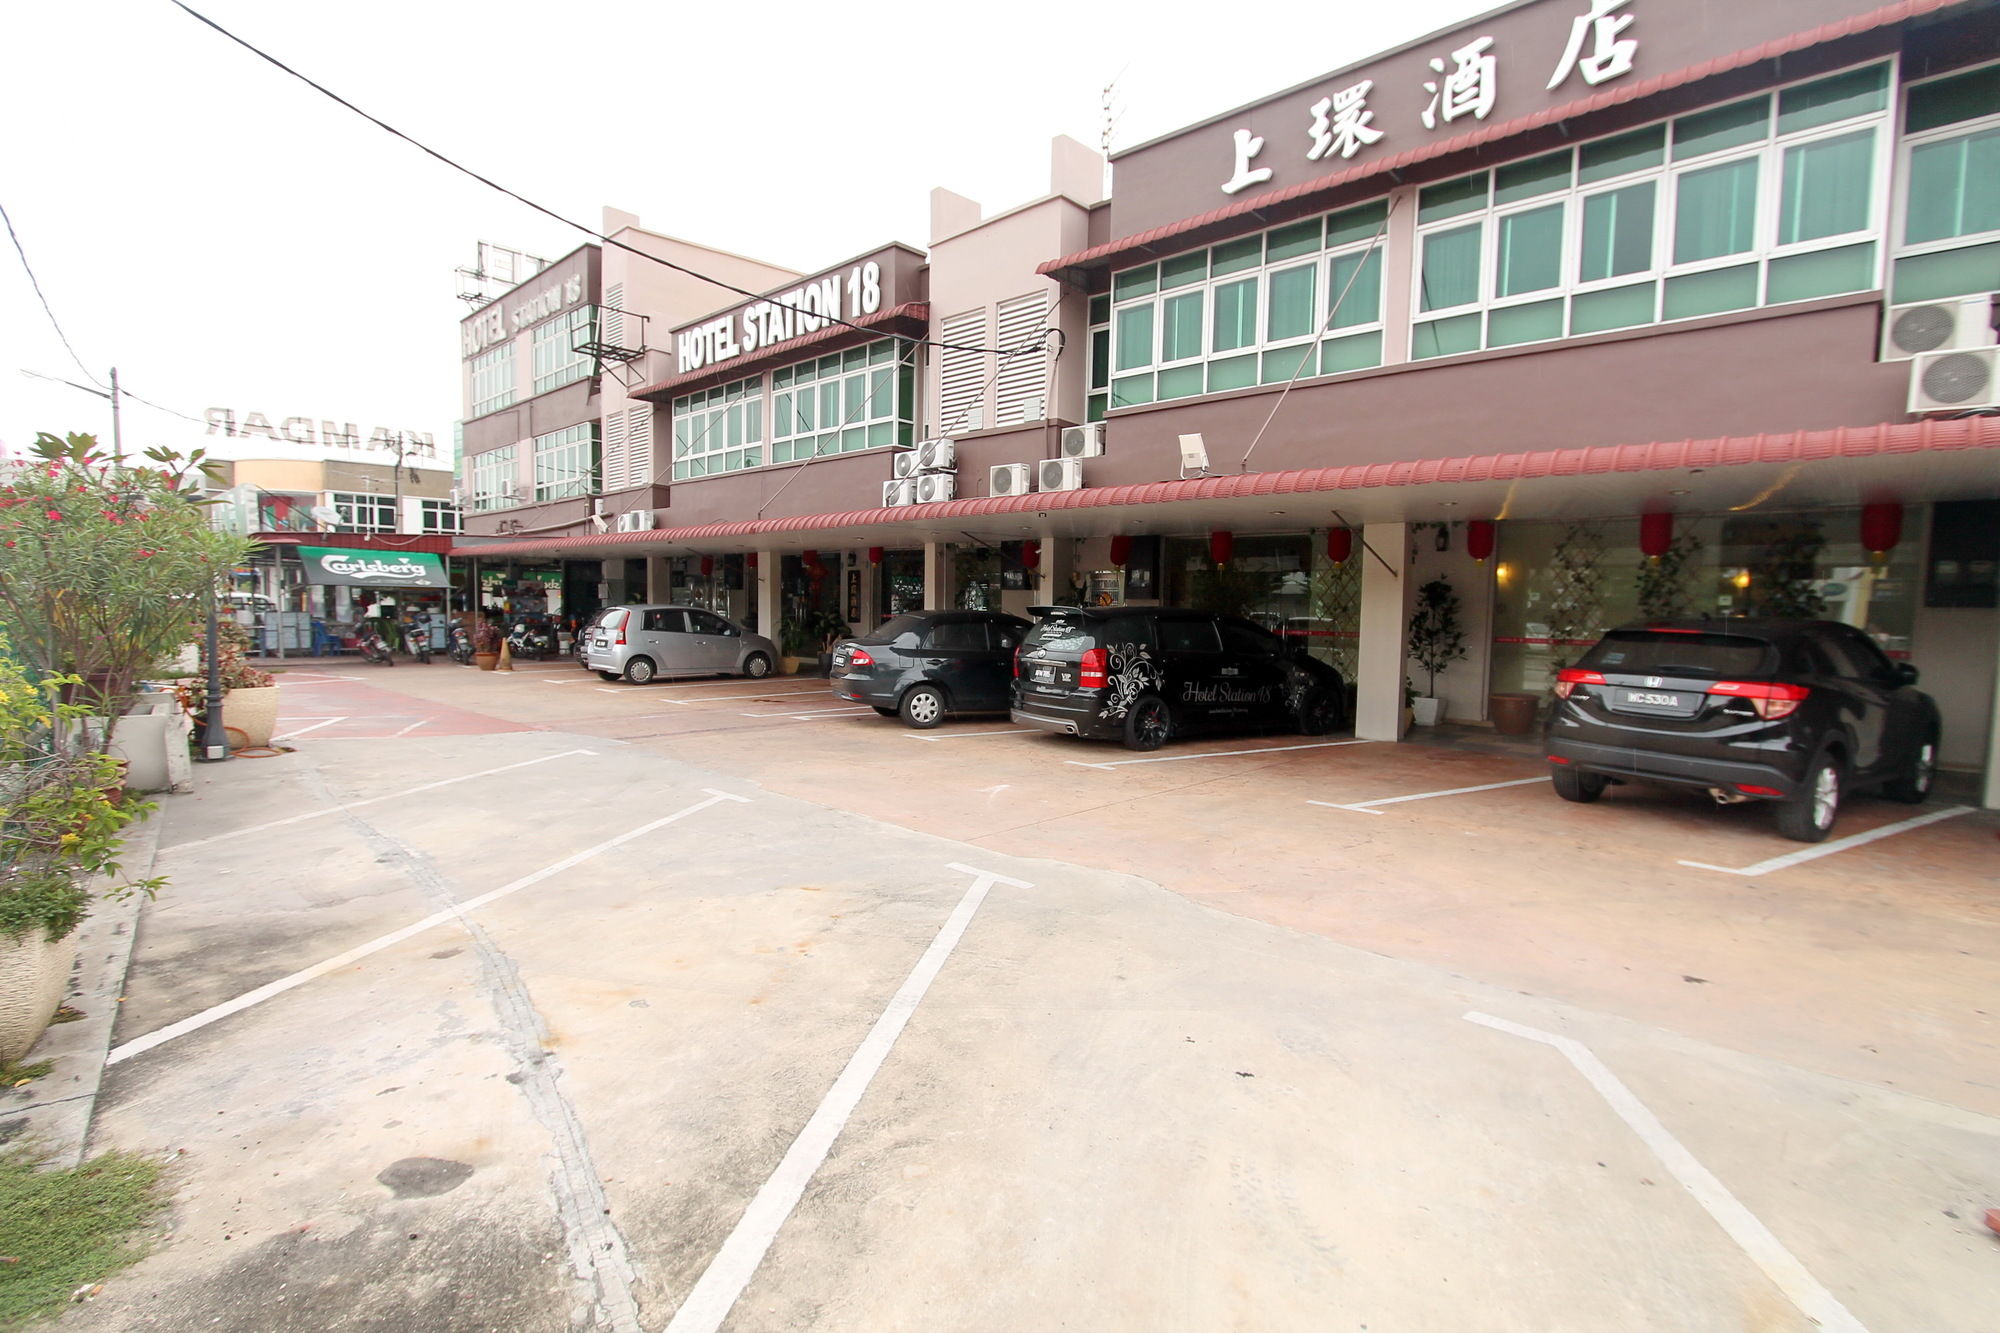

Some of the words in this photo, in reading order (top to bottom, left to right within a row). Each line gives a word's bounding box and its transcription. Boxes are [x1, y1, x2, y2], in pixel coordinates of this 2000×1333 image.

[1221, 0, 1638, 194] 上環酒店
[462, 303, 508, 359] HOTEL
[511, 283, 563, 334] STATION
[678, 314, 740, 374] HOTEL
[742, 274, 841, 352] STATION
[848, 261, 881, 317] 18
[320, 554, 427, 578] Carlsberg
[1183, 681, 1217, 702] Hotel
[1218, 681, 1257, 703] Station
[1257, 685, 1272, 703] 18
